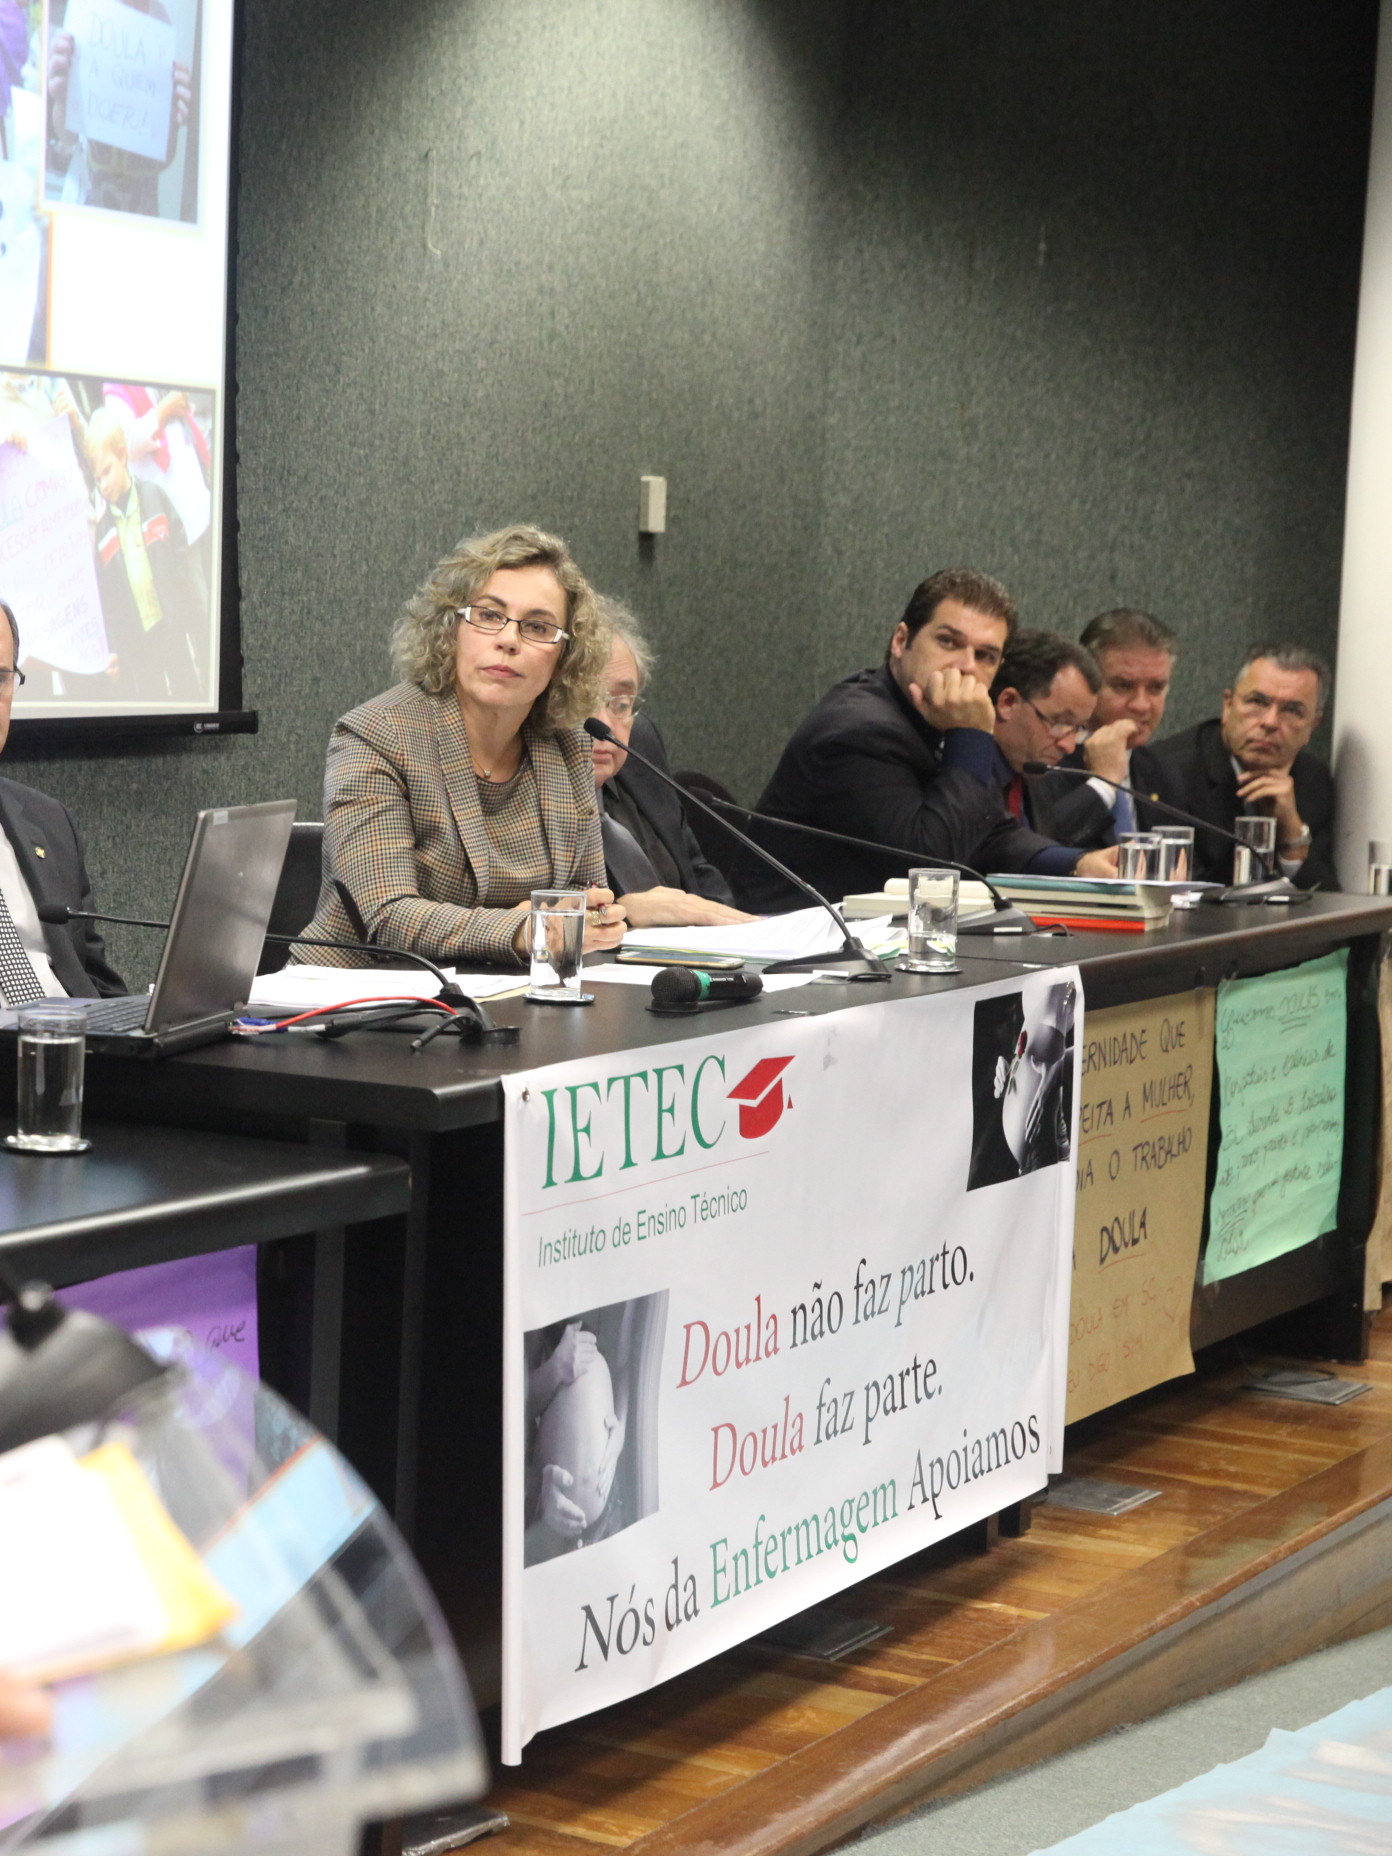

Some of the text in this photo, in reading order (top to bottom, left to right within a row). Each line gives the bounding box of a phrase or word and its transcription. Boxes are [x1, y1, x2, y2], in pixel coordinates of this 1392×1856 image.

[88, 10, 146, 64] DOULA
[1081, 1028, 1148, 1077] ERNIDADE
[1160, 1018, 1186, 1054] QUE
[541, 1054, 727, 1190] IETEC
[1122, 1091, 1132, 1121] A
[1142, 1064, 1195, 1112] MULHER,
[1108, 1149, 1120, 1180] O
[1132, 1126, 1193, 1172] TRABALHO
[538, 1186, 748, 1269] Instituto de Ensino Técnico
[1099, 1206, 1148, 1266] DOULA
[676, 1239, 975, 1390] Doula não faz parto.
[708, 1354, 943, 1492] Doula faz parte.
[574, 1413, 1041, 1673] Nós da Enfermagem Apoiamos
